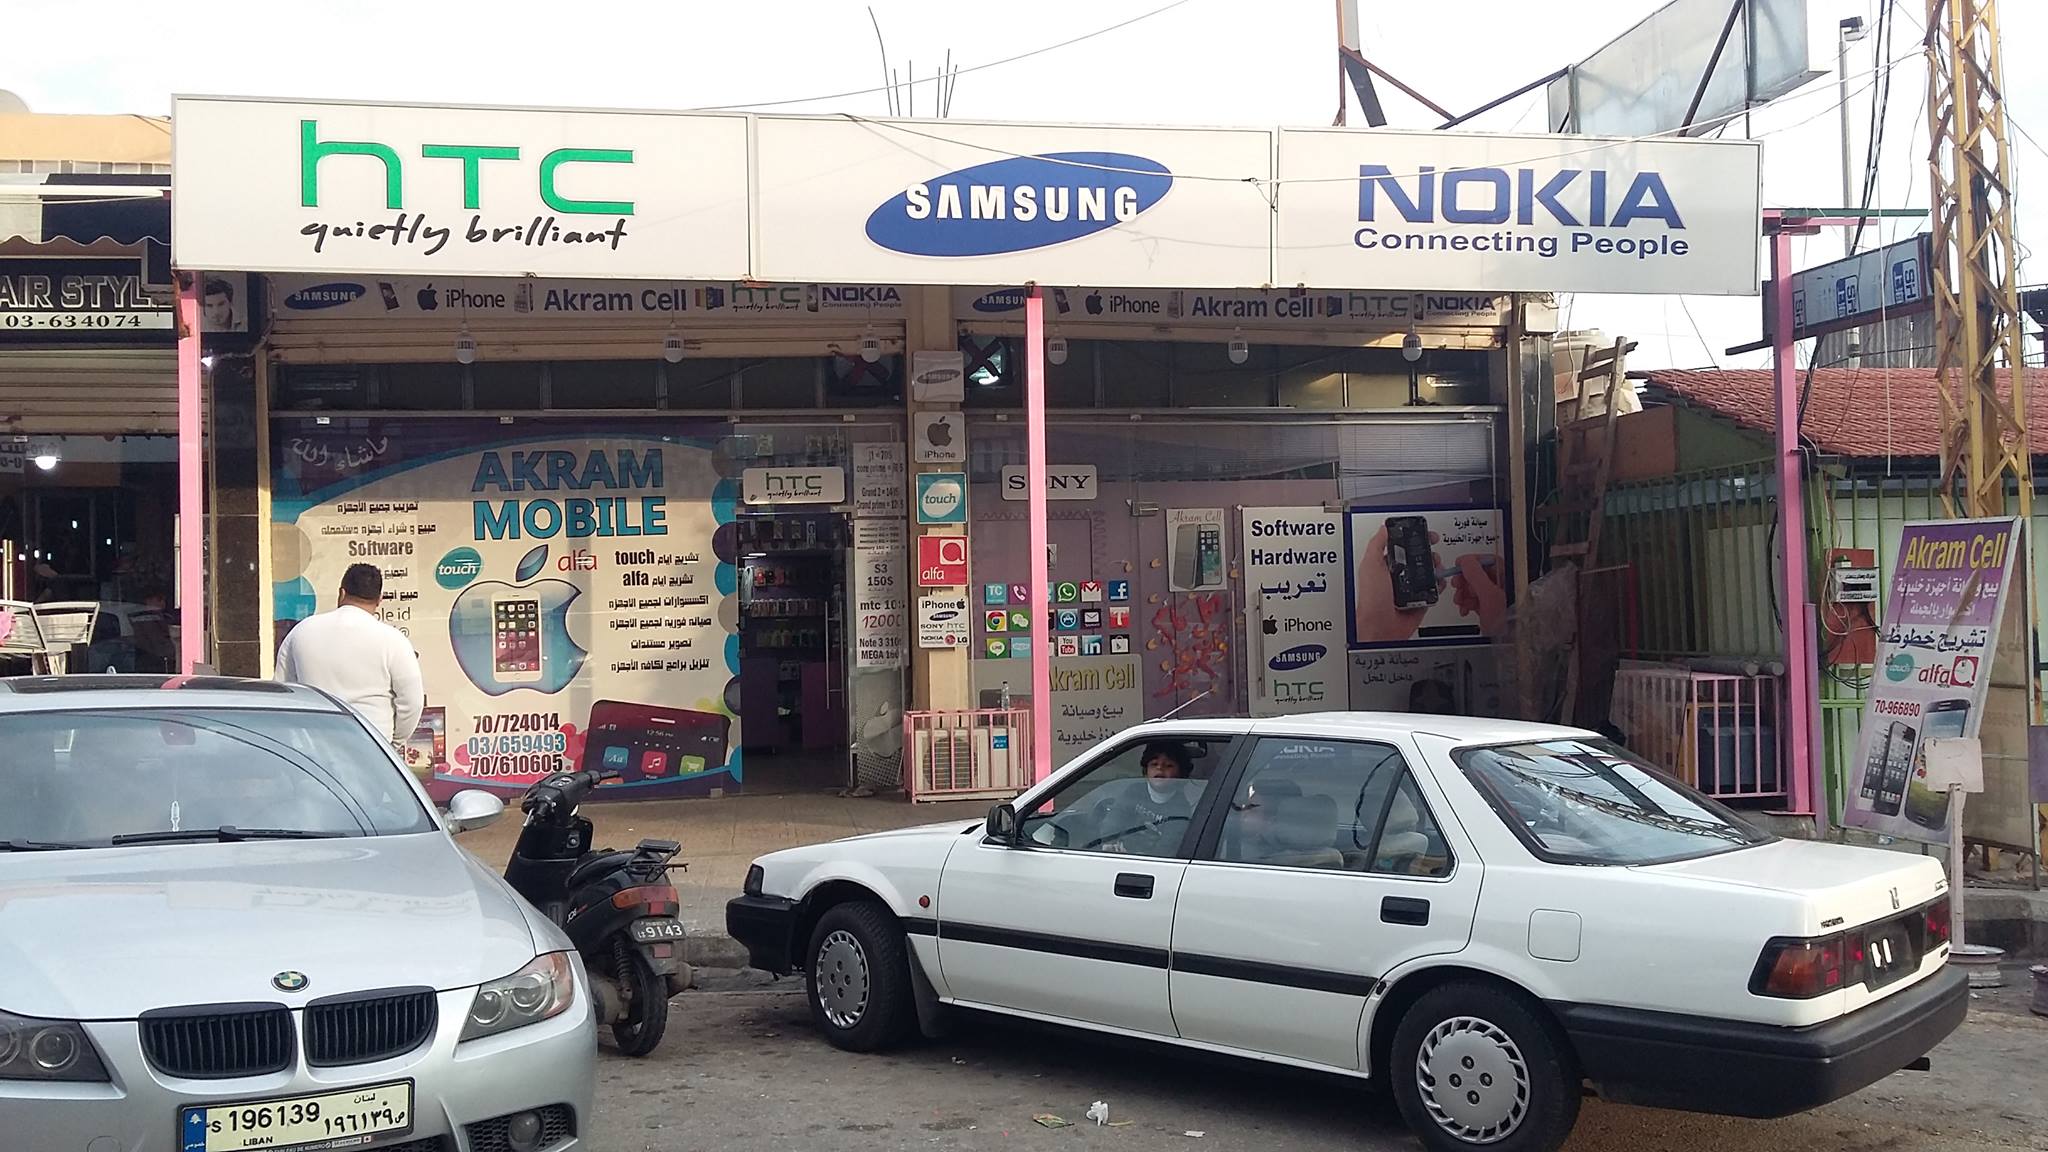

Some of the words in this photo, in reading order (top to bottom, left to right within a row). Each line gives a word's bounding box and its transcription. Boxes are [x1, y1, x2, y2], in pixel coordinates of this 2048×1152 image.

[905, 182, 1139, 222] SAMSUNG
[1357, 164, 1687, 230] NOKIA
[301, 212, 450, 255] quietly
[467, 213, 628, 251] brilliant
[1354, 228, 1559, 258] Connecting
[1571, 231, 1690, 260] People
[61, 275, 173, 309] STYL
[294, 289, 358, 302] SAMSUNG
[446, 288, 506, 310] iPhone
[543, 288, 634, 312] Akram
[641, 288, 687, 312] Cell
[821, 286, 902, 302] NOKIA
[1109, 295, 1160, 314] iPhone
[1191, 296, 1268, 317] Akram
[1274, 295, 1314, 318] Cell
[1426, 296, 1496, 311] NOKIA
[5, 314, 142, 328] 03-634074
[924, 450, 956, 459] iPhone
[471, 448, 664, 493] AKRAM
[1008, 475, 1091, 490] SNY
[925, 492, 957, 504] touch
[473, 495, 669, 541] MOBILE
[1250, 519, 1336, 537] Software
[348, 539, 414, 557] Software
[615, 548, 655, 566] touch
[1250, 548, 1338, 566] Hardware
[1902, 535, 1967, 571] Akram
[1968, 531, 2008, 569] Cell
[438, 563, 477, 576] touch
[557, 548, 598, 573] alfa
[874, 563, 888, 574] S3
[622, 570, 649, 587] alfa
[922, 566, 945, 580] alfa
[1259, 572, 1328, 600] تعريب
[398, 606, 411, 621] id
[860, 600, 881, 611] mtc
[921, 600, 956, 609] iPhone
[1284, 618, 1333, 632] iPhone
[859, 637, 877, 648] Note
[878, 637, 884, 647] 3
[957, 636, 968, 644] LG
[1937, 629, 1987, 654] تشريج
[861, 649, 884, 660] MEGA
[1275, 650, 1321, 664] SAMSUNG
[1105, 663, 1136, 690] Cell
[1918, 663, 1951, 684] alfa
[1874, 699, 1921, 718] 70-966890
[473, 712, 560, 734] 70/724014
[467, 734, 566, 756] 03/659493
[1057, 729, 1097, 745] خليوية
[470, 753, 563, 776] 70/610605
[645, 924, 683, 938] 9143
[353, 1092, 377, 1105] لبنان
[228, 1101, 321, 1132] 196139
[243, 1135, 273, 1147] LIBAN
